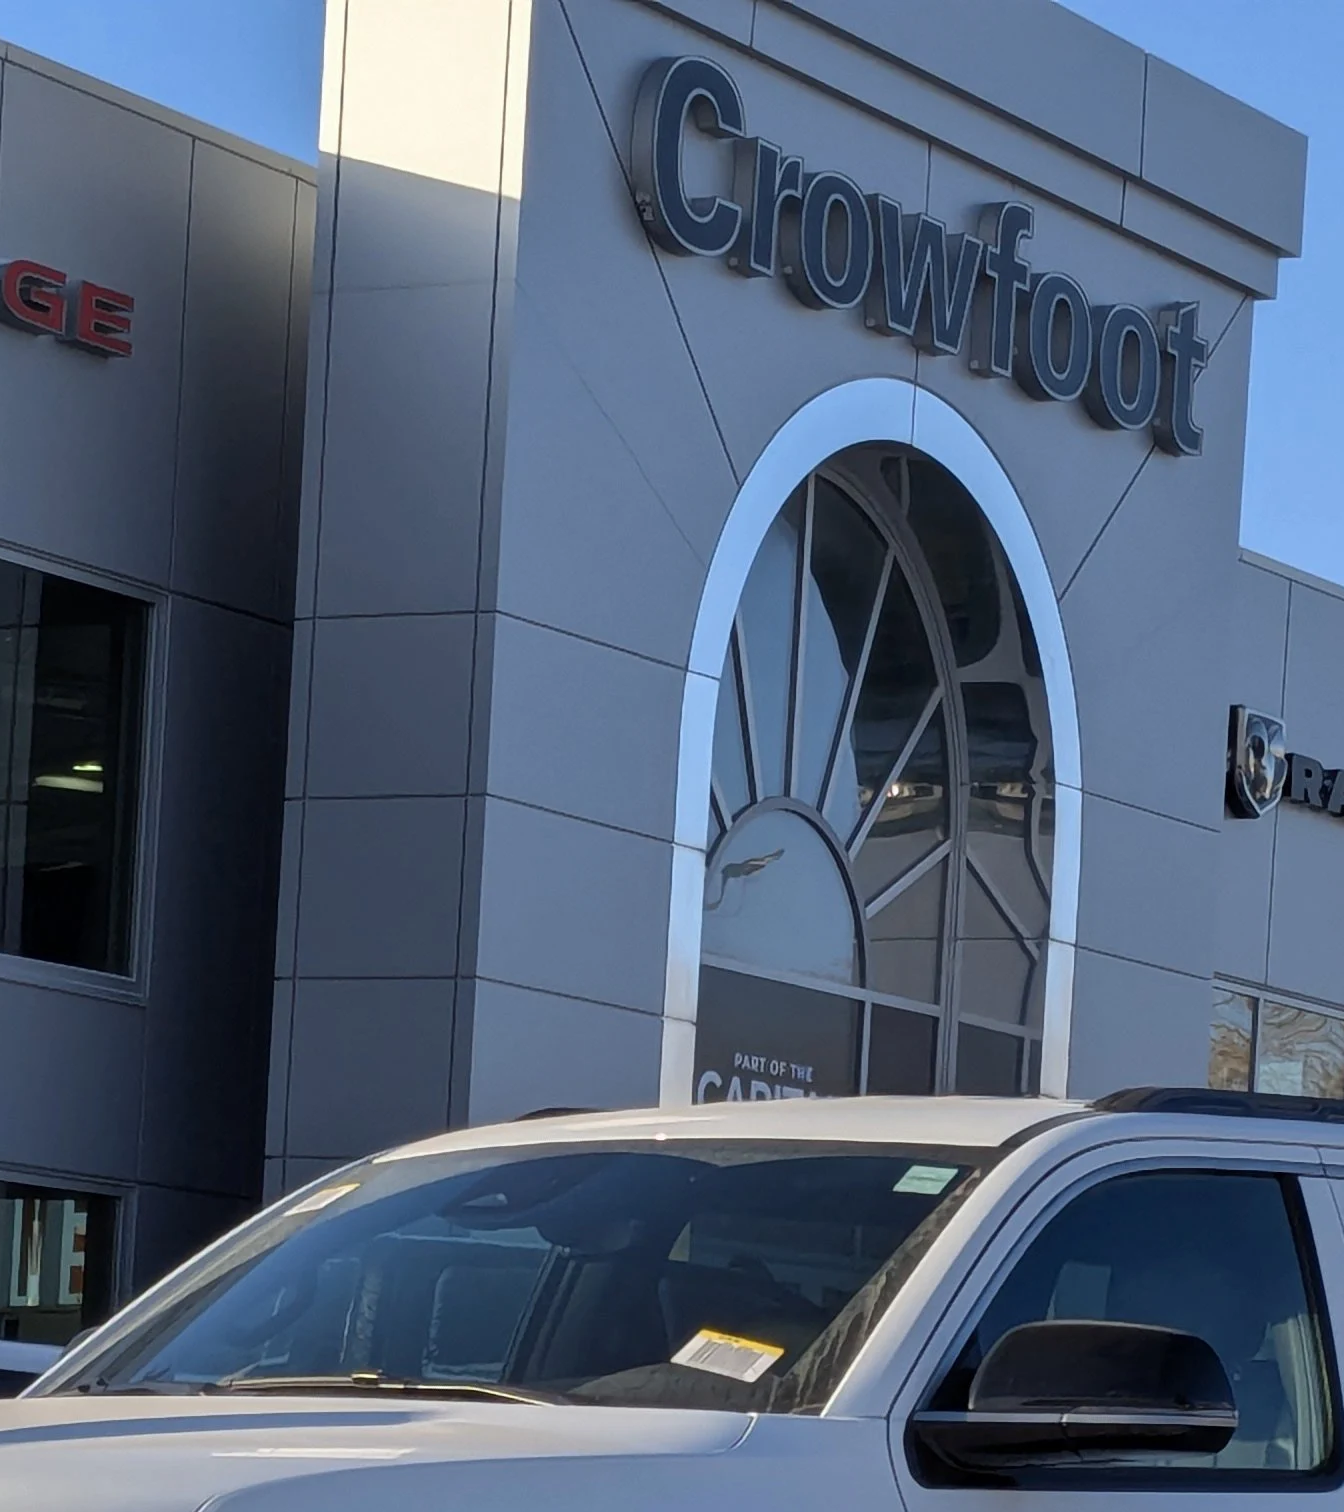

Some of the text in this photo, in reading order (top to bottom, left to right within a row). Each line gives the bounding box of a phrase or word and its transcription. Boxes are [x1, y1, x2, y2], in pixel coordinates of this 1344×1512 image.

[634, 55, 1208, 456] Crowfoot
[734, 1052, 814, 1083] PART OF THE
